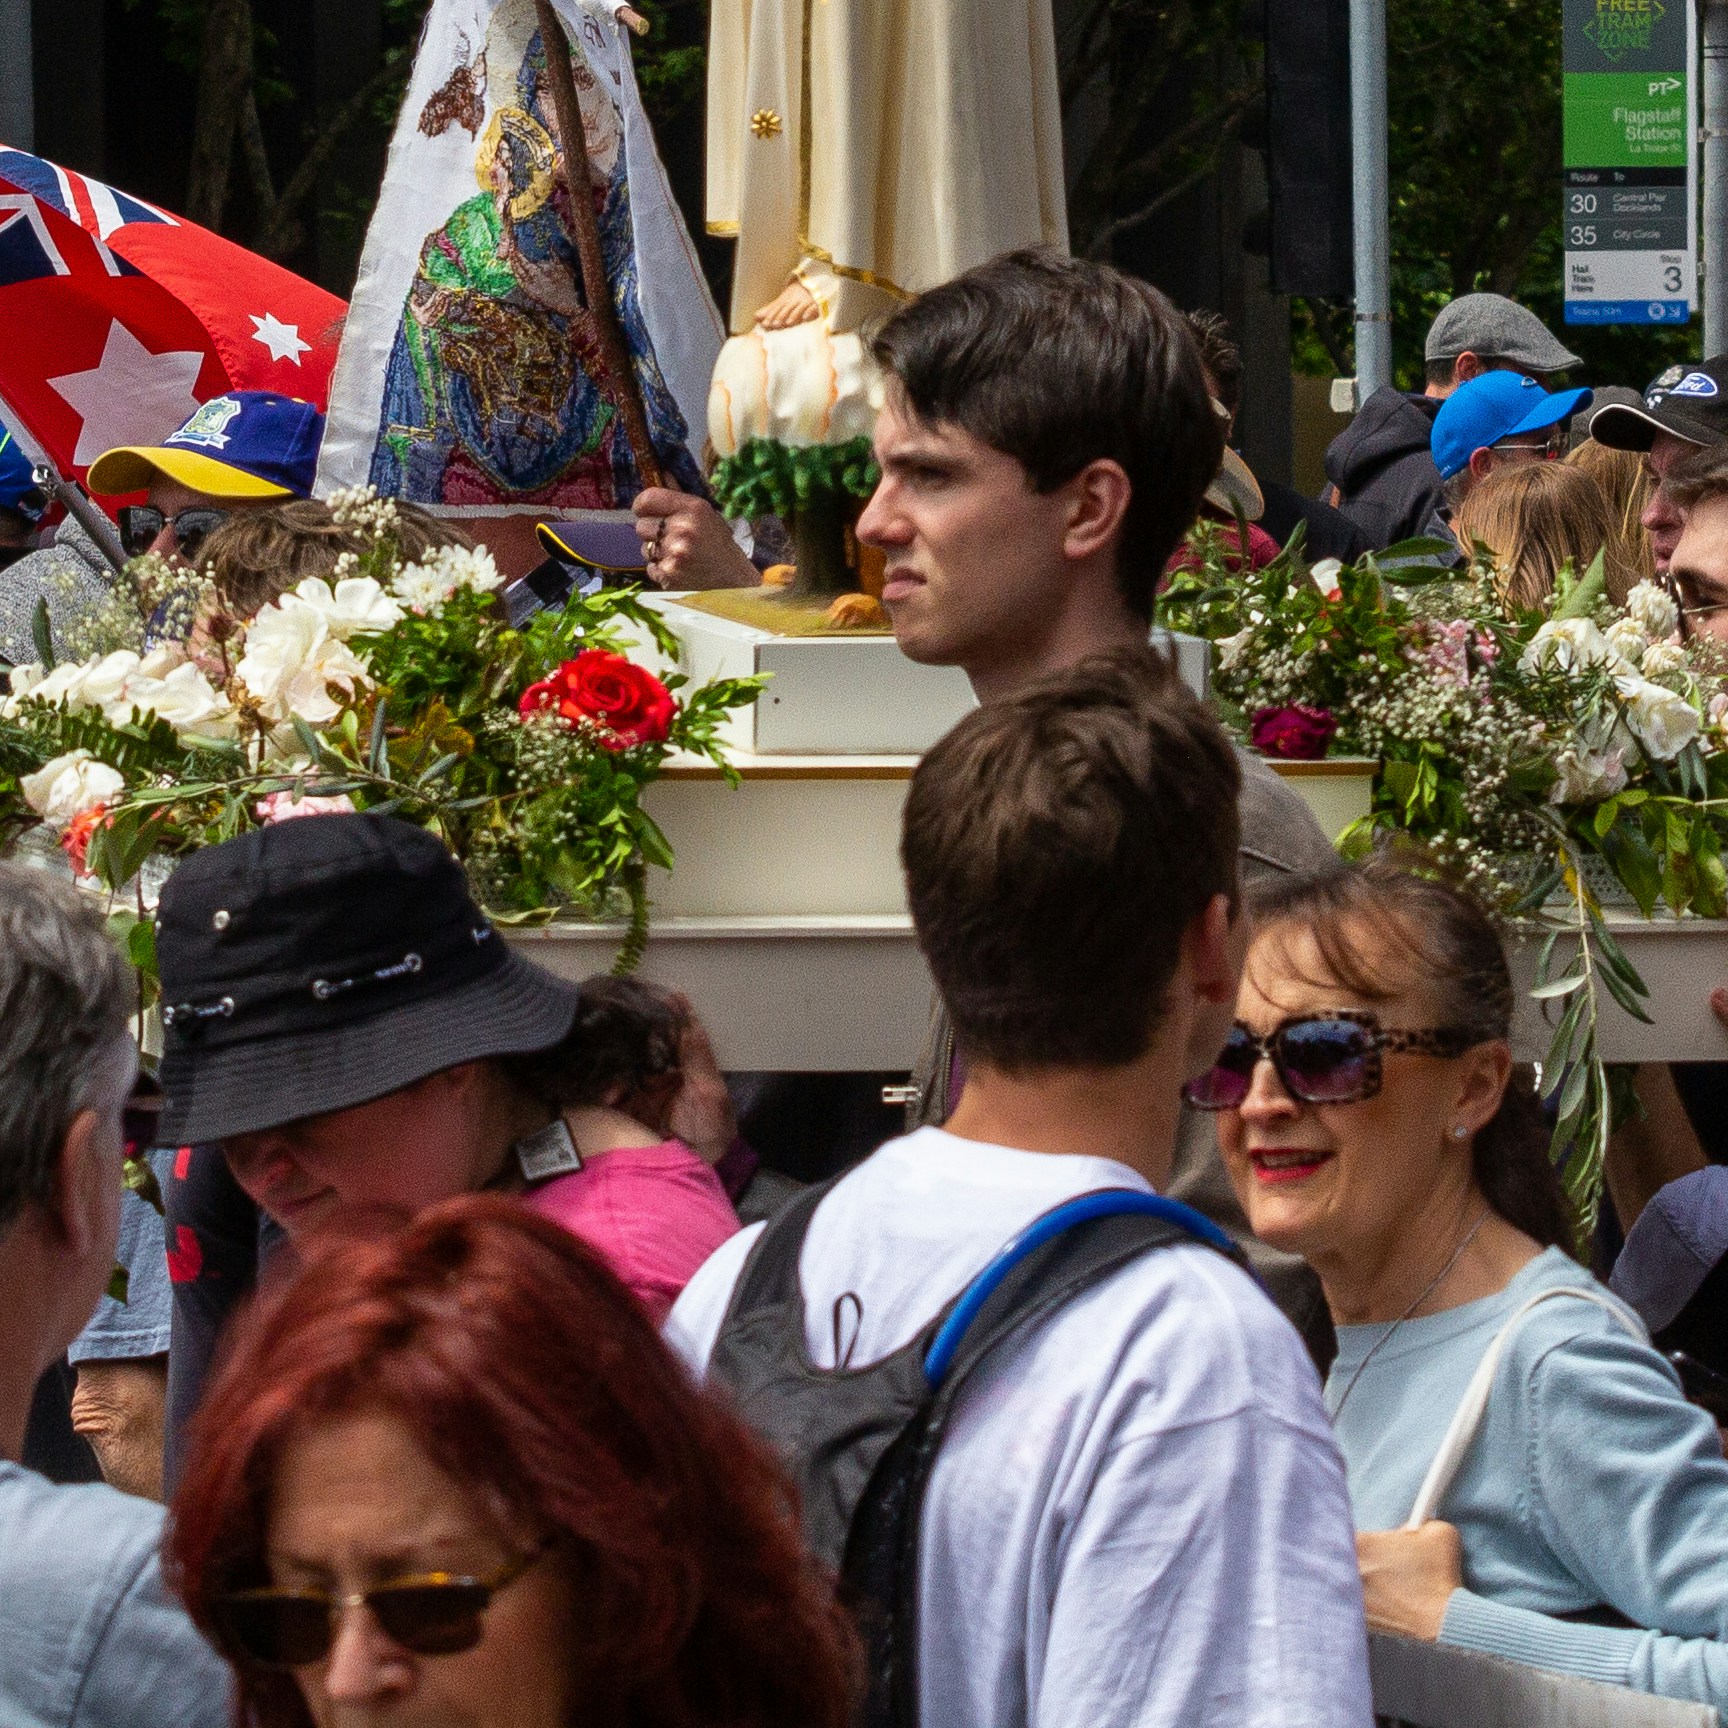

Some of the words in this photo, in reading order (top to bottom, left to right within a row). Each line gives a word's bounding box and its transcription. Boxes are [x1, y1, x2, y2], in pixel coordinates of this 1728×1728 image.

[1597, 12, 1652, 29] TRAM
[1597, 30, 1651, 49] ZONE
[1613, 107, 1682, 127] Flagstaff
[1625, 125, 1682, 141] Station
[1614, 172, 1626, 182] To
[1570, 194, 1597, 214] 30
[1570, 226, 1597, 246] 35
[1664, 265, 1683, 293] 3
